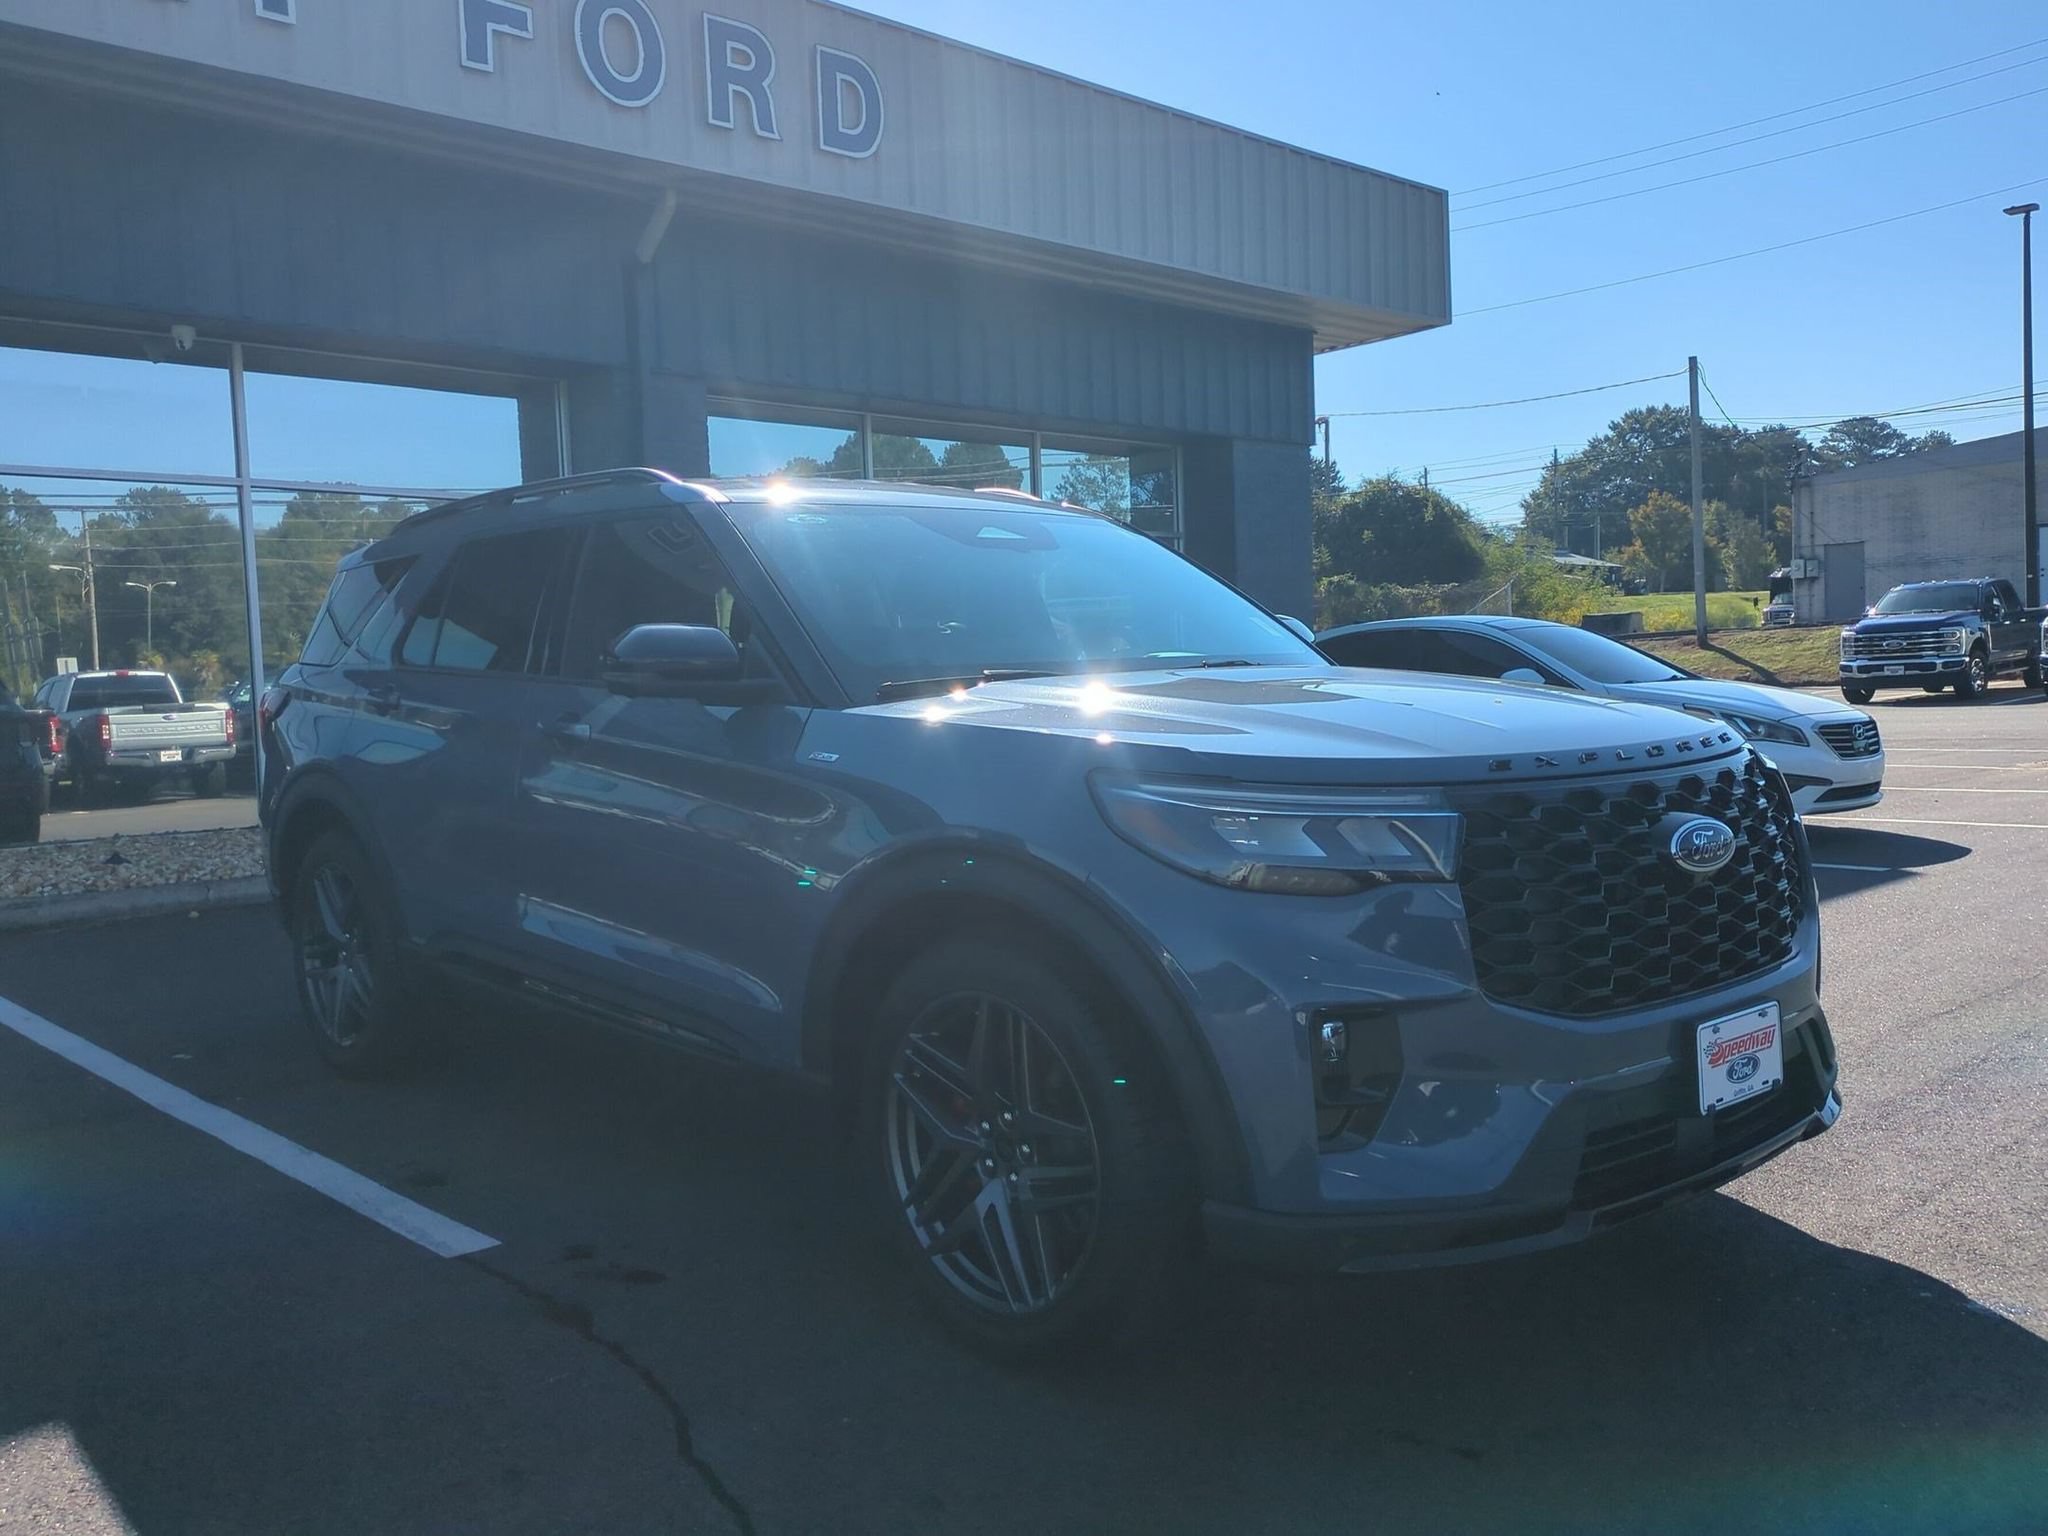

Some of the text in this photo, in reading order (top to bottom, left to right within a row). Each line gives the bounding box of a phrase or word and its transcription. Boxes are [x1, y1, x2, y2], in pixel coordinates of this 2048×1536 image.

[1488, 732, 1733, 772] EXPLORER
[1691, 830, 1731, 860] Ford
[1708, 1029, 1776, 1066] Speedway
[1732, 1057, 1754, 1080] Ford
